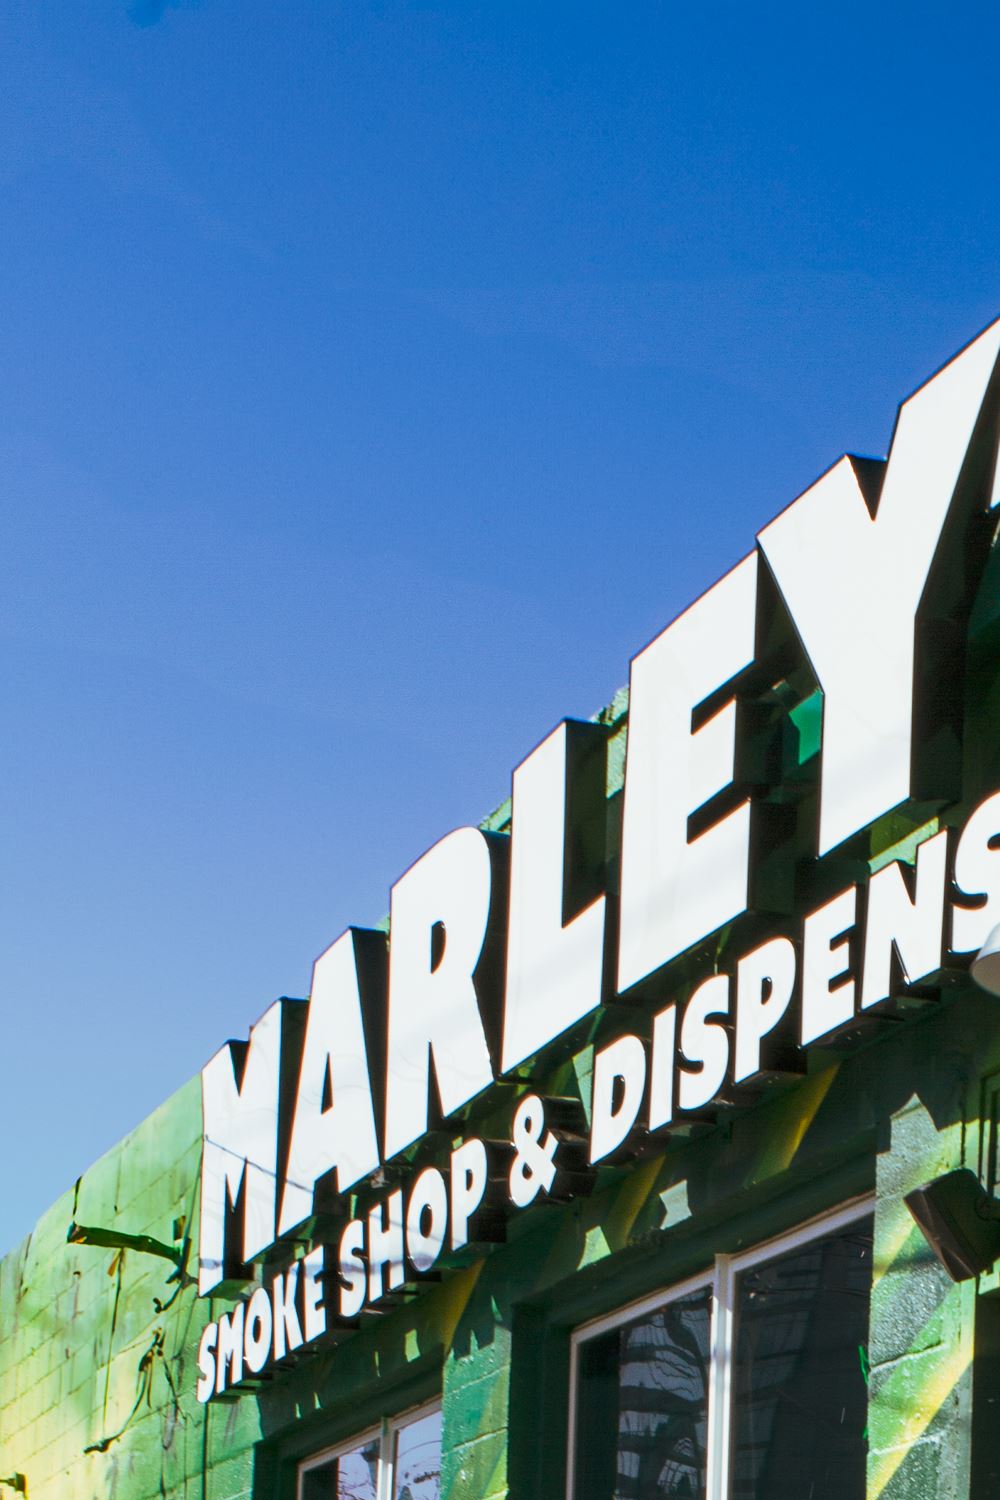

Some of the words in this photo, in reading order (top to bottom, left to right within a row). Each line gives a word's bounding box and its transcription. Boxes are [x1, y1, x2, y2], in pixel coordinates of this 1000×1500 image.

[197, 1244, 328, 1403] SMOKE
[338, 1137, 488, 1318] SHOP
[508, 1093, 560, 1209] &
